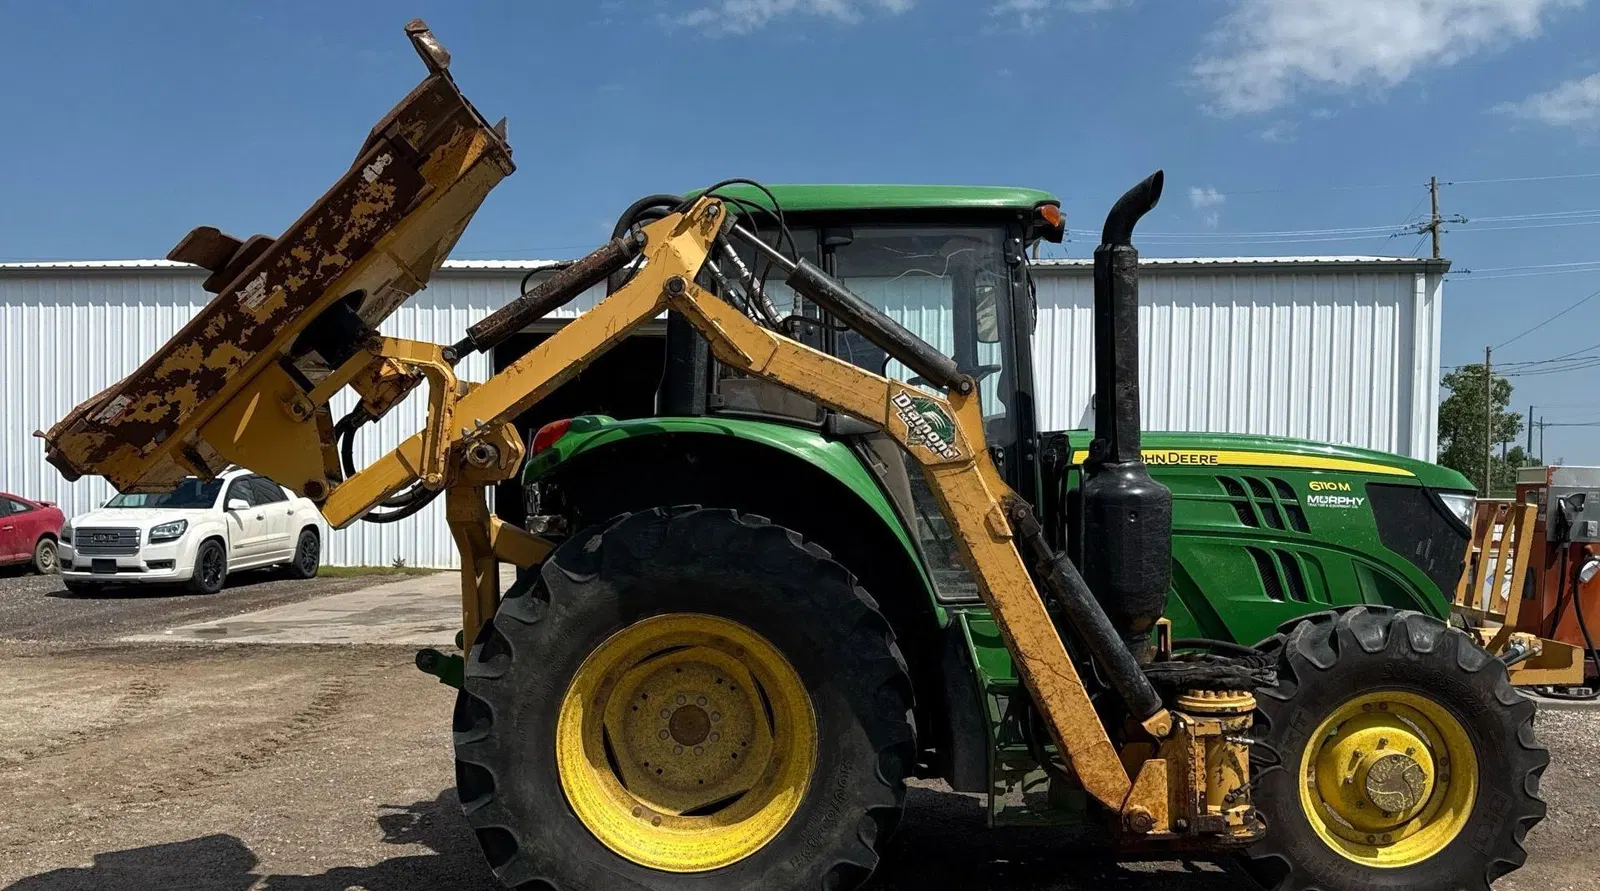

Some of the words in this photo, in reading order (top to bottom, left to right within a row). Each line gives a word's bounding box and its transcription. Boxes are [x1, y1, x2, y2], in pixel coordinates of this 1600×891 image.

[894, 392, 960, 459] Diamond
[1140, 454, 1166, 464] HN
[1168, 452, 1218, 464] DEERE
[1307, 494, 1365, 506] MURPHY
